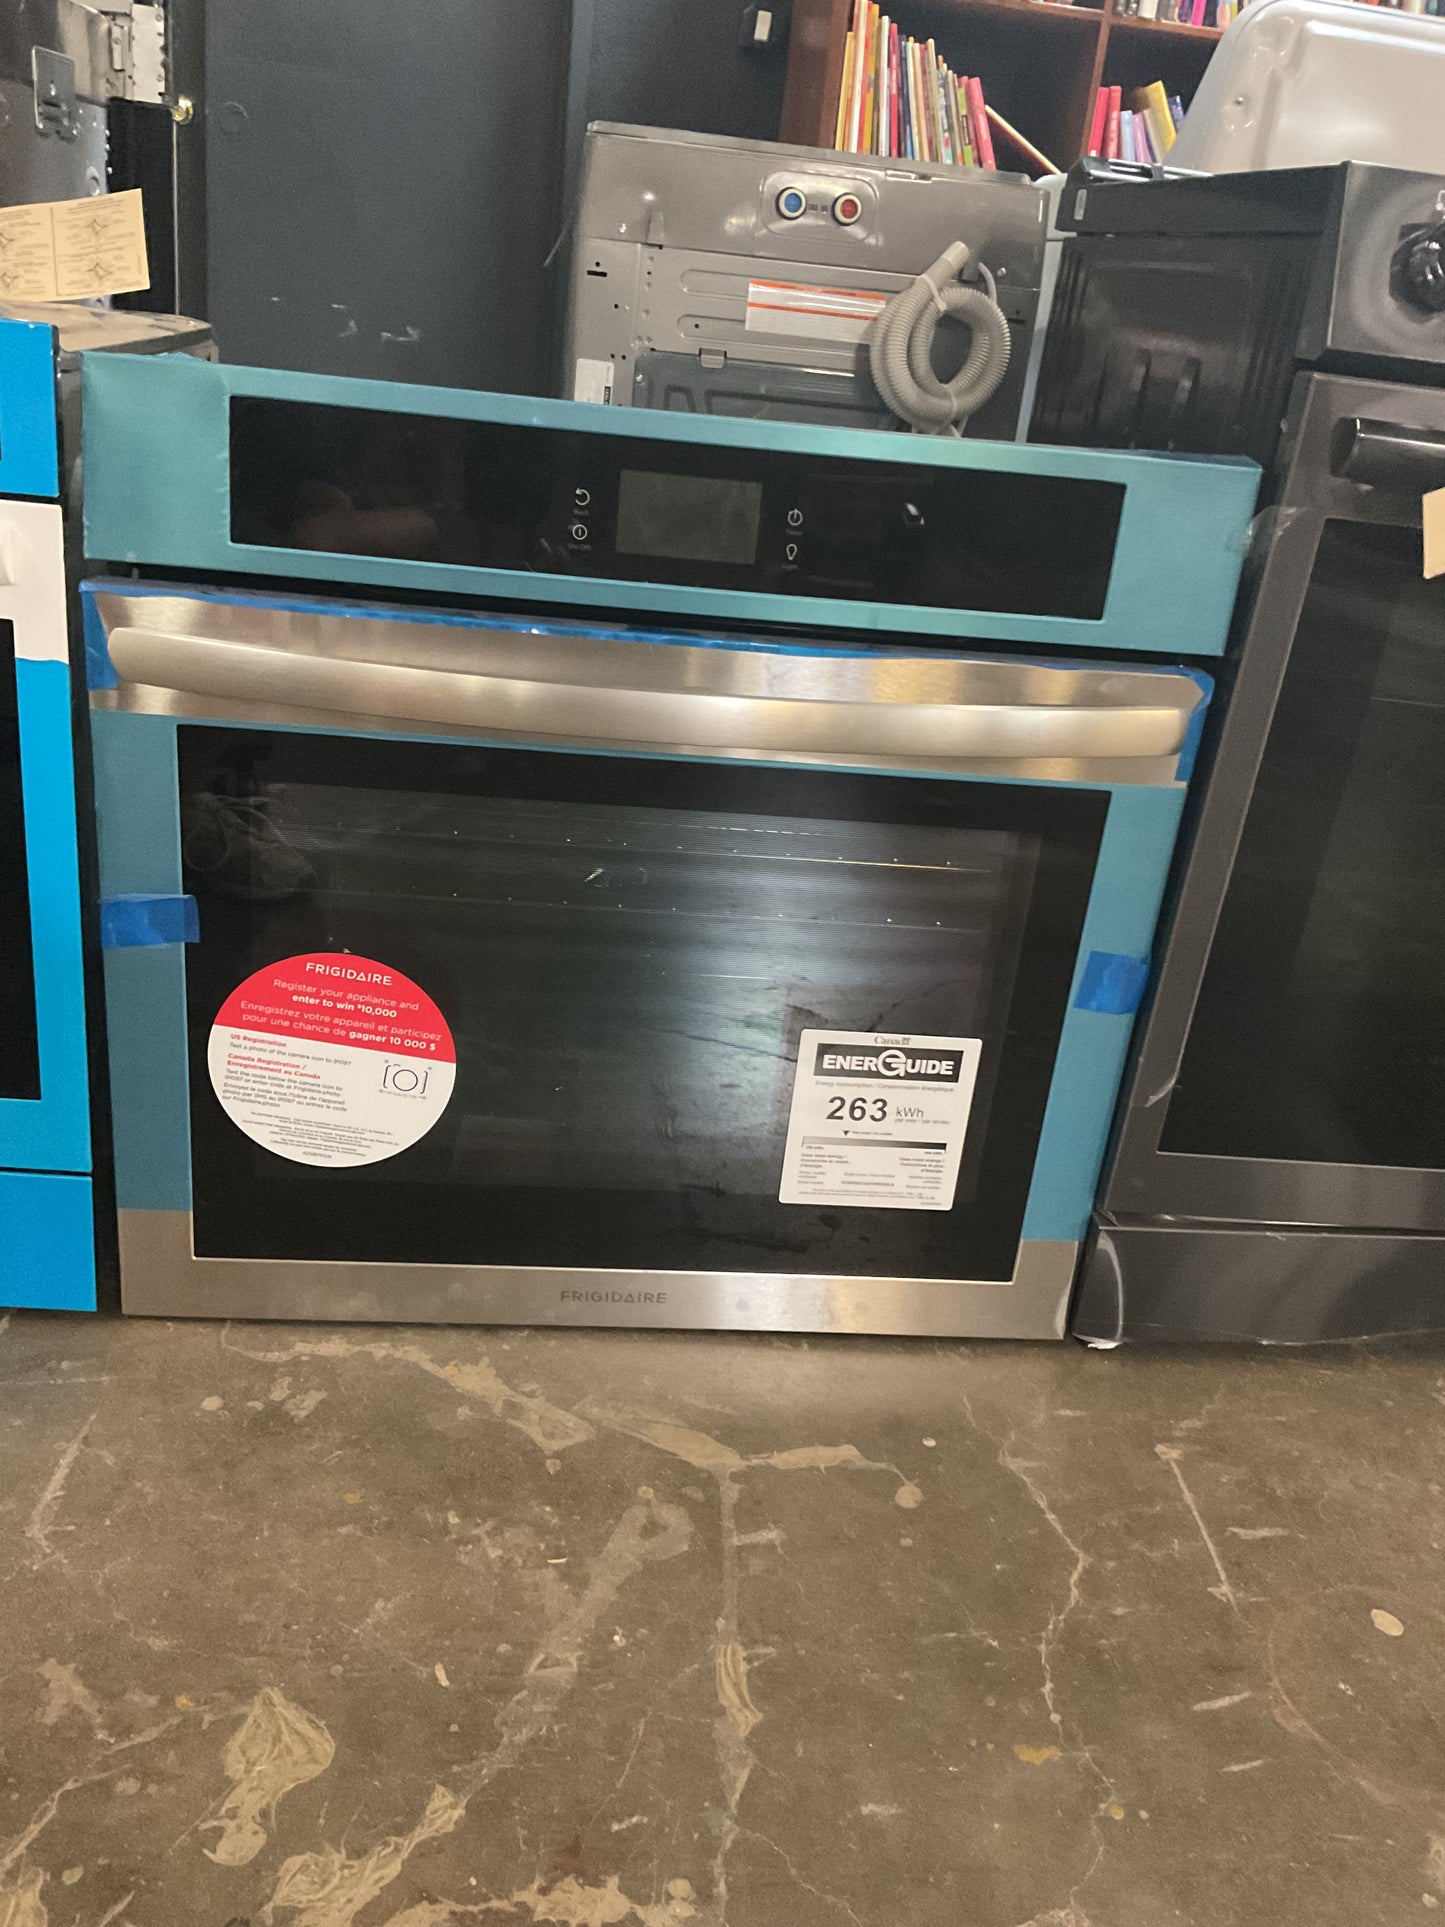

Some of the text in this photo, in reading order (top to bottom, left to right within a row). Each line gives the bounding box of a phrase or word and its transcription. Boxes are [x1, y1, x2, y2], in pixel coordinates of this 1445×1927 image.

[306, 962, 392, 986] FRIGIDAIRE
[273, 978, 419, 1010] Register your appliance and
[292, 994, 397, 1018] enter to win $10,000
[240, 1000, 442, 1040] Enregistrez votre appareil et participez
[242, 1014, 436, 1051] pour une chance de gagner 10 000 $
[243, 1036, 286, 1047] Registration
[874, 1036, 910, 1046] Canada
[227, 1060, 281, 1073] Enregistrement
[294, 1070, 320, 1079] Canada
[228, 1053, 255, 1061] Canada
[257, 1058, 300, 1069] Registration
[822, 1050, 954, 1076] ENERGUIDE
[825, 1095, 888, 1122] 263
[896, 1106, 924, 1118] kWh
[560, 1290, 667, 1304] FRIGIDAIRE
